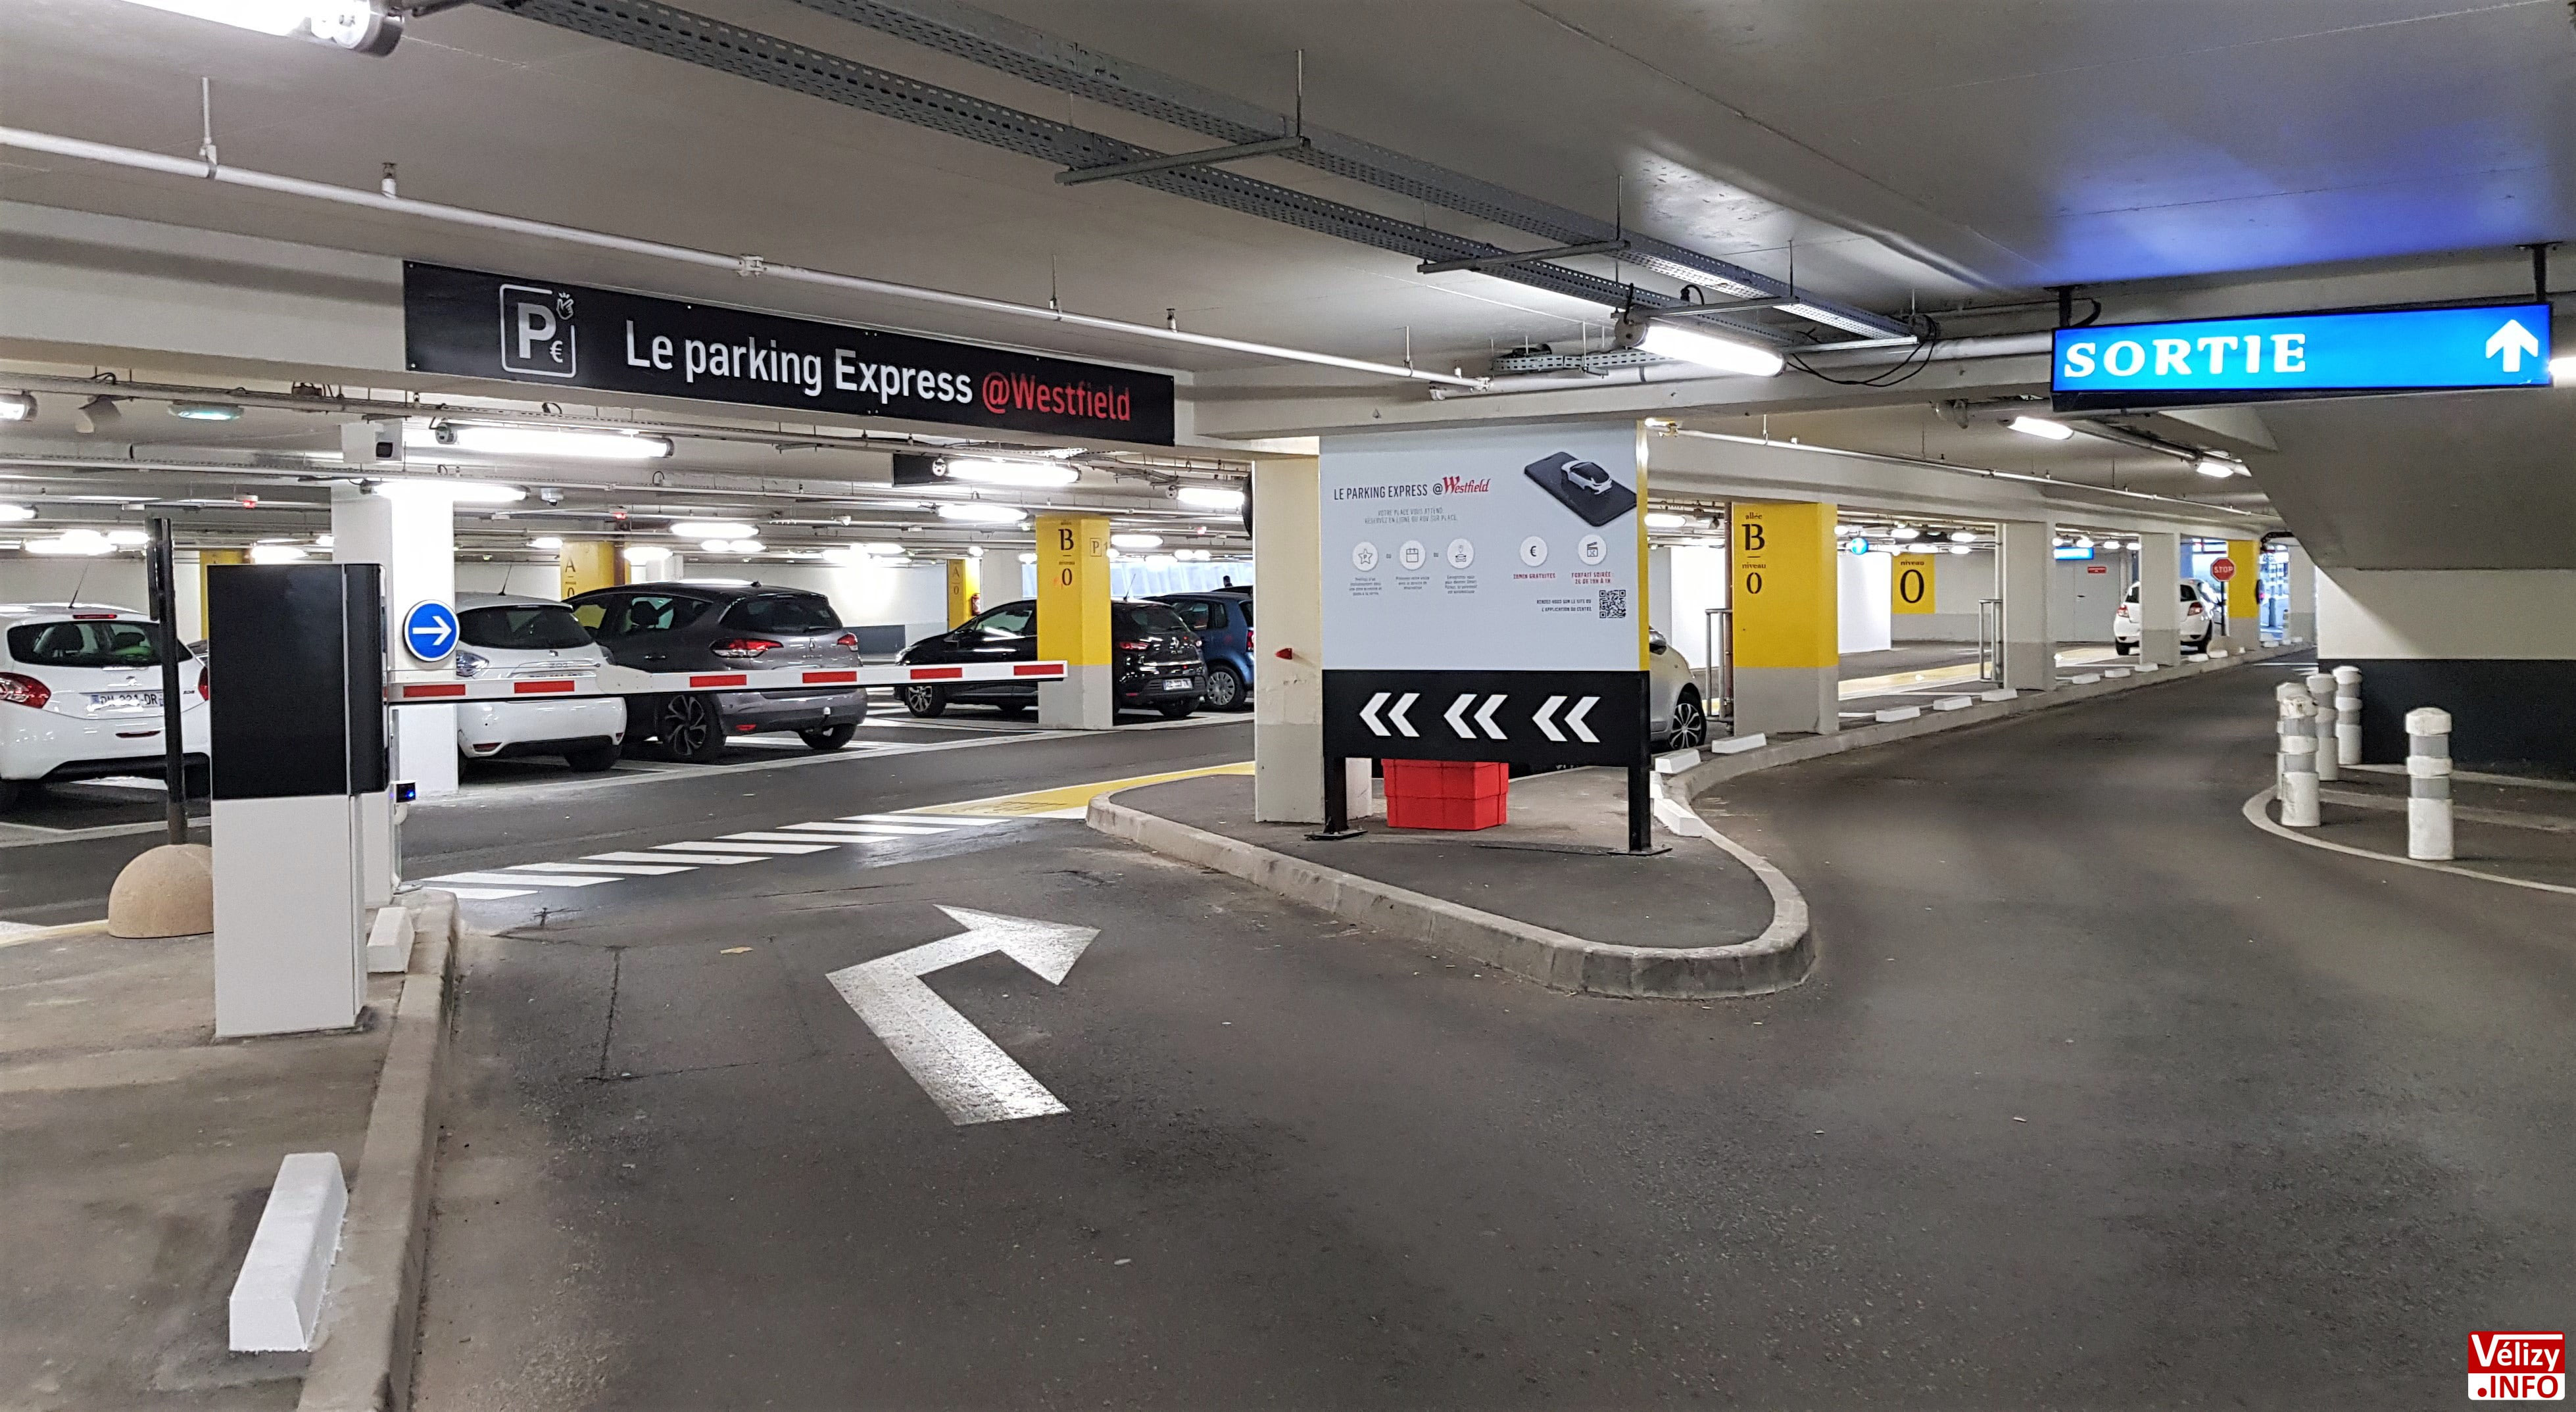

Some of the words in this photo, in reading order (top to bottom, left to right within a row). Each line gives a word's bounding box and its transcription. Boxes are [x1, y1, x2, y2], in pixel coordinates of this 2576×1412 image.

[518, 303, 556, 359] P
[2064, 333, 2306, 377] SORTIE
[627, 320, 673, 370] Le
[685, 337, 821, 397] parking
[835, 349, 973, 404] Express
[983, 372, 1131, 422] @Westfield
[1334, 489, 1344, 500] LE
[1347, 487, 1386, 499] PARKING
[1388, 484, 1428, 498] EXPRESS
[1057, 528, 1074, 550] B
[1092, 541, 1100, 554] P
[1741, 523, 1766, 551] B
[565, 556, 576, 572] A
[1061, 568, 1073, 586] 0
[1746, 572, 1762, 595] 0
